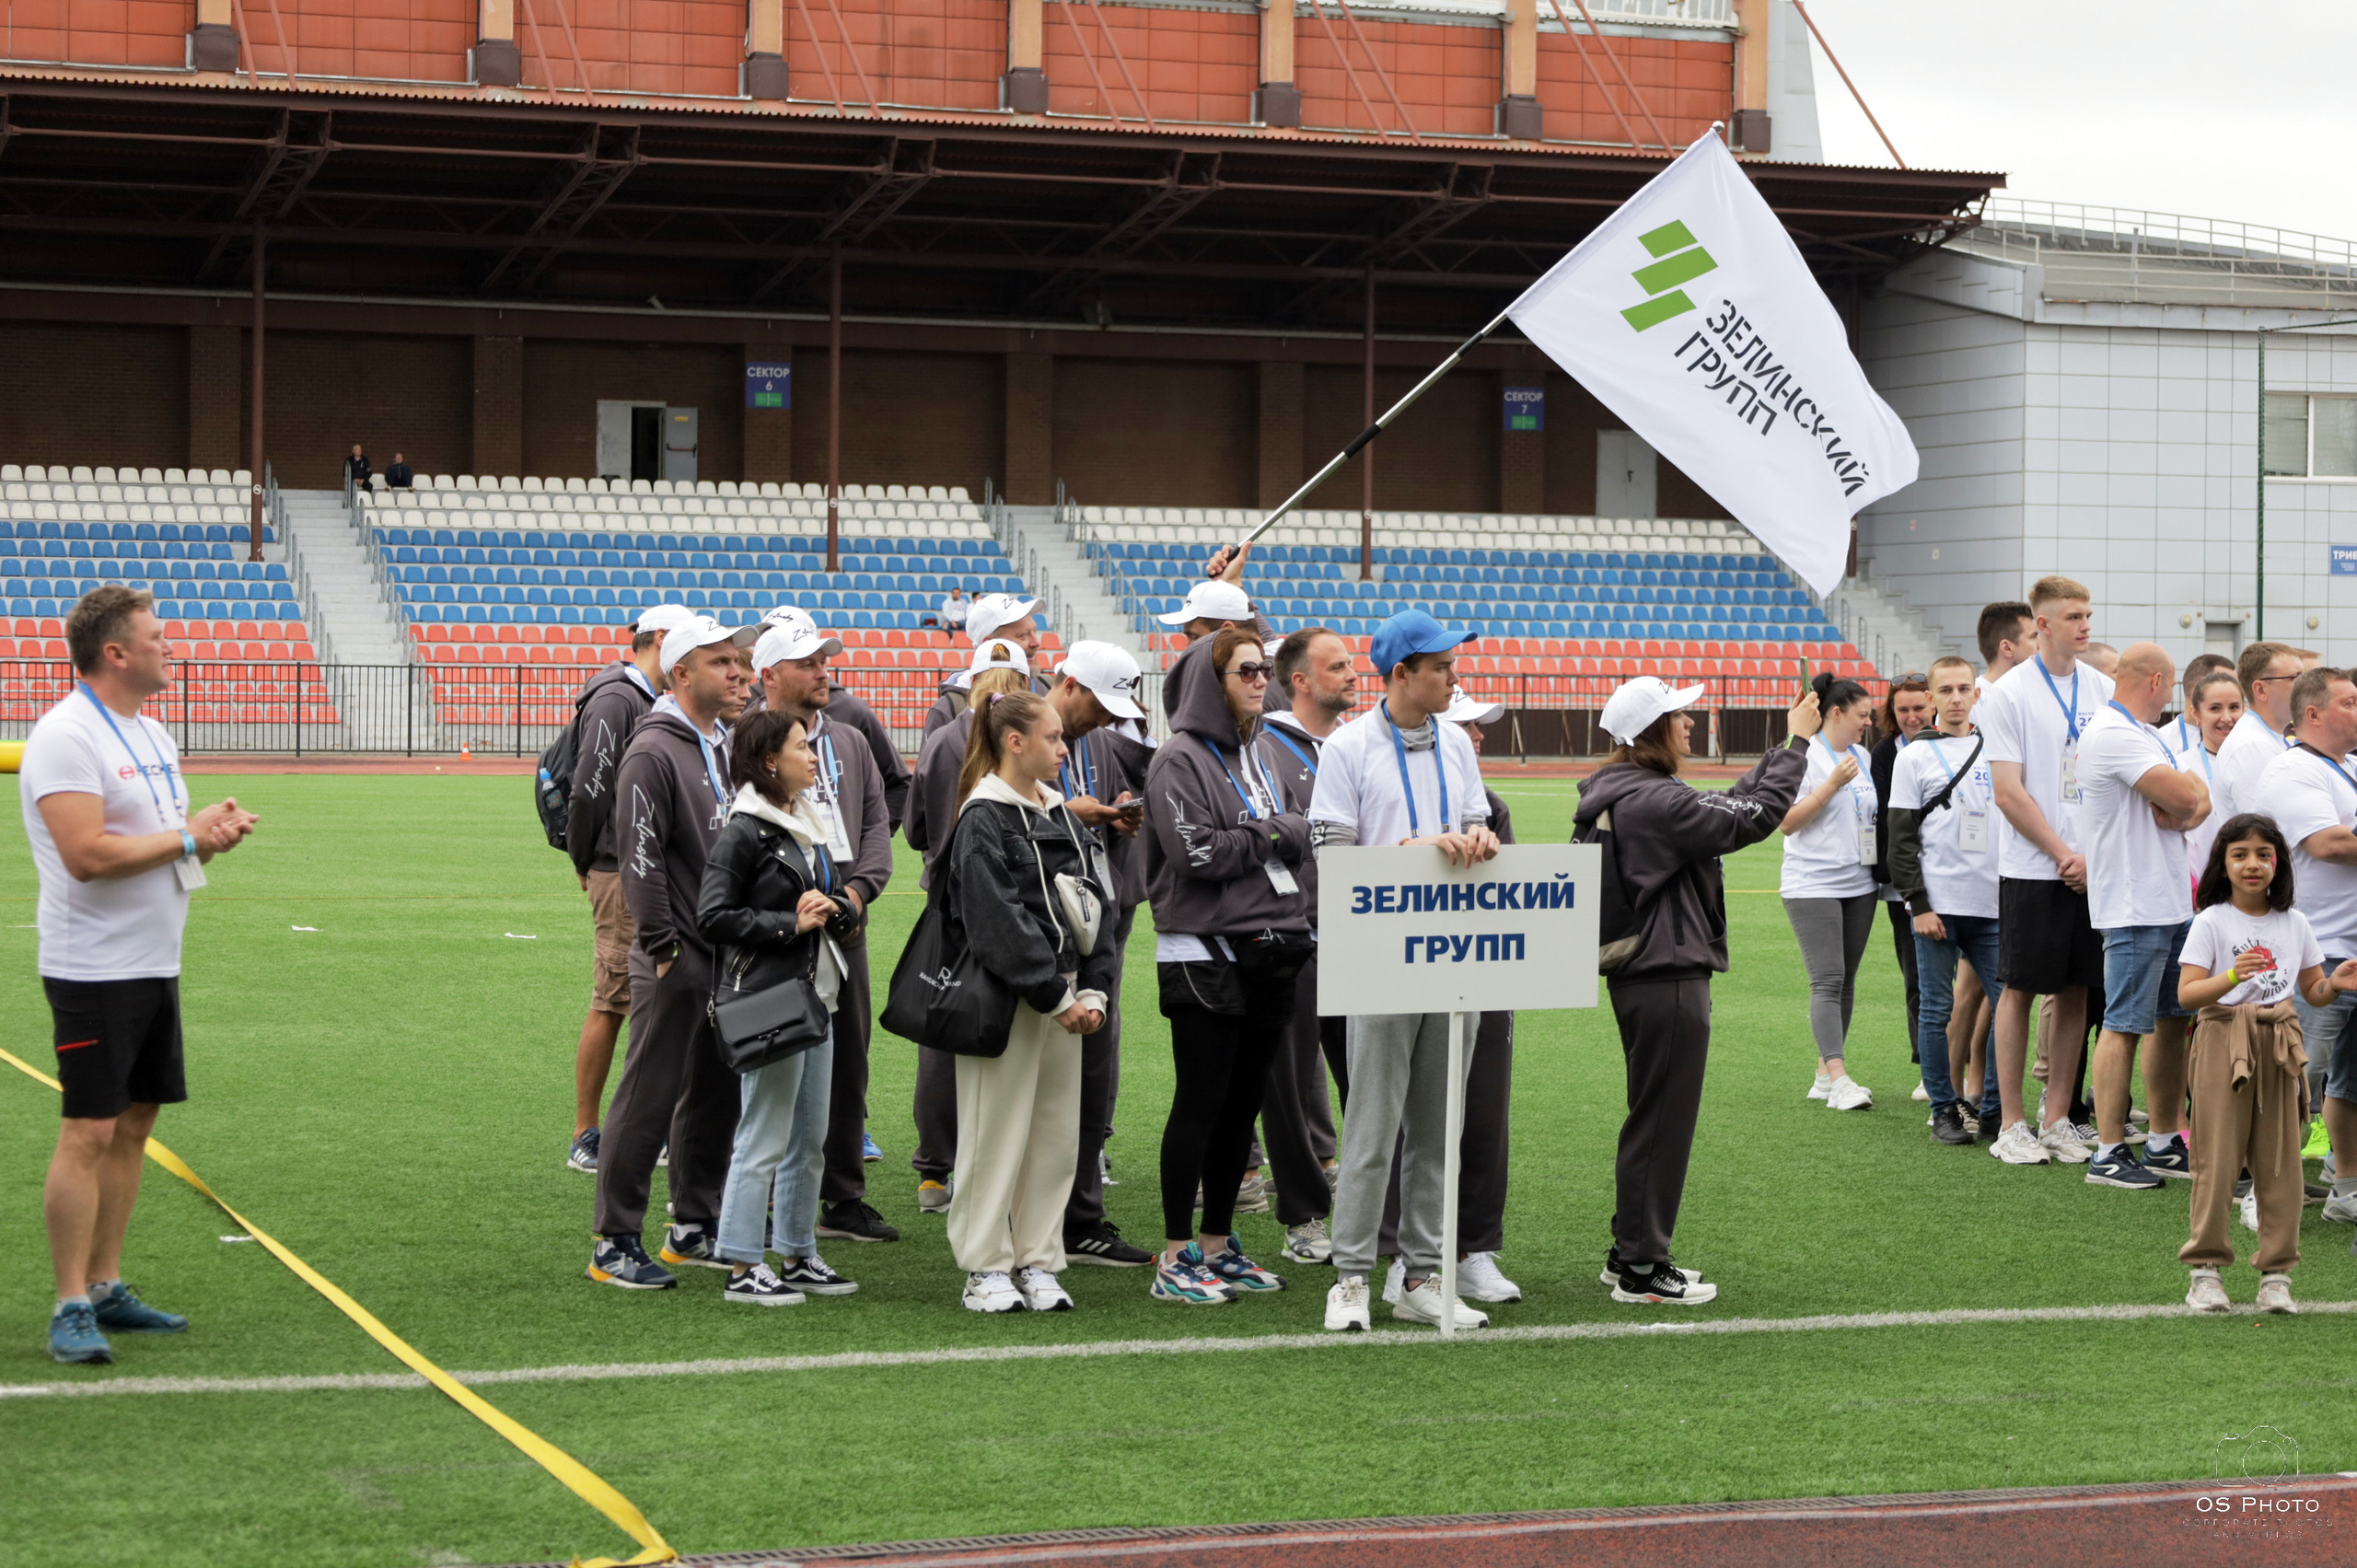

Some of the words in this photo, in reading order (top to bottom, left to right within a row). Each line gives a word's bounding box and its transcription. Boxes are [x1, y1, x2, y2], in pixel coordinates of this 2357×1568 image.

[747, 366, 790, 378] СЕКТОР
[765, 380, 773, 391] 6
[1674, 331, 1778, 436] ГРУПП
[1504, 391, 1543, 402] СЕКТОР
[1521, 404, 1528, 414] 7
[1706, 299, 1869, 497] ЗЕЛИНСКИЙ
[631, 784, 656, 879] Zelinsky
[1351, 872, 1575, 914] ЗЕЛИНСКИЙ
[1404, 933, 1526, 964] ГРУПП
